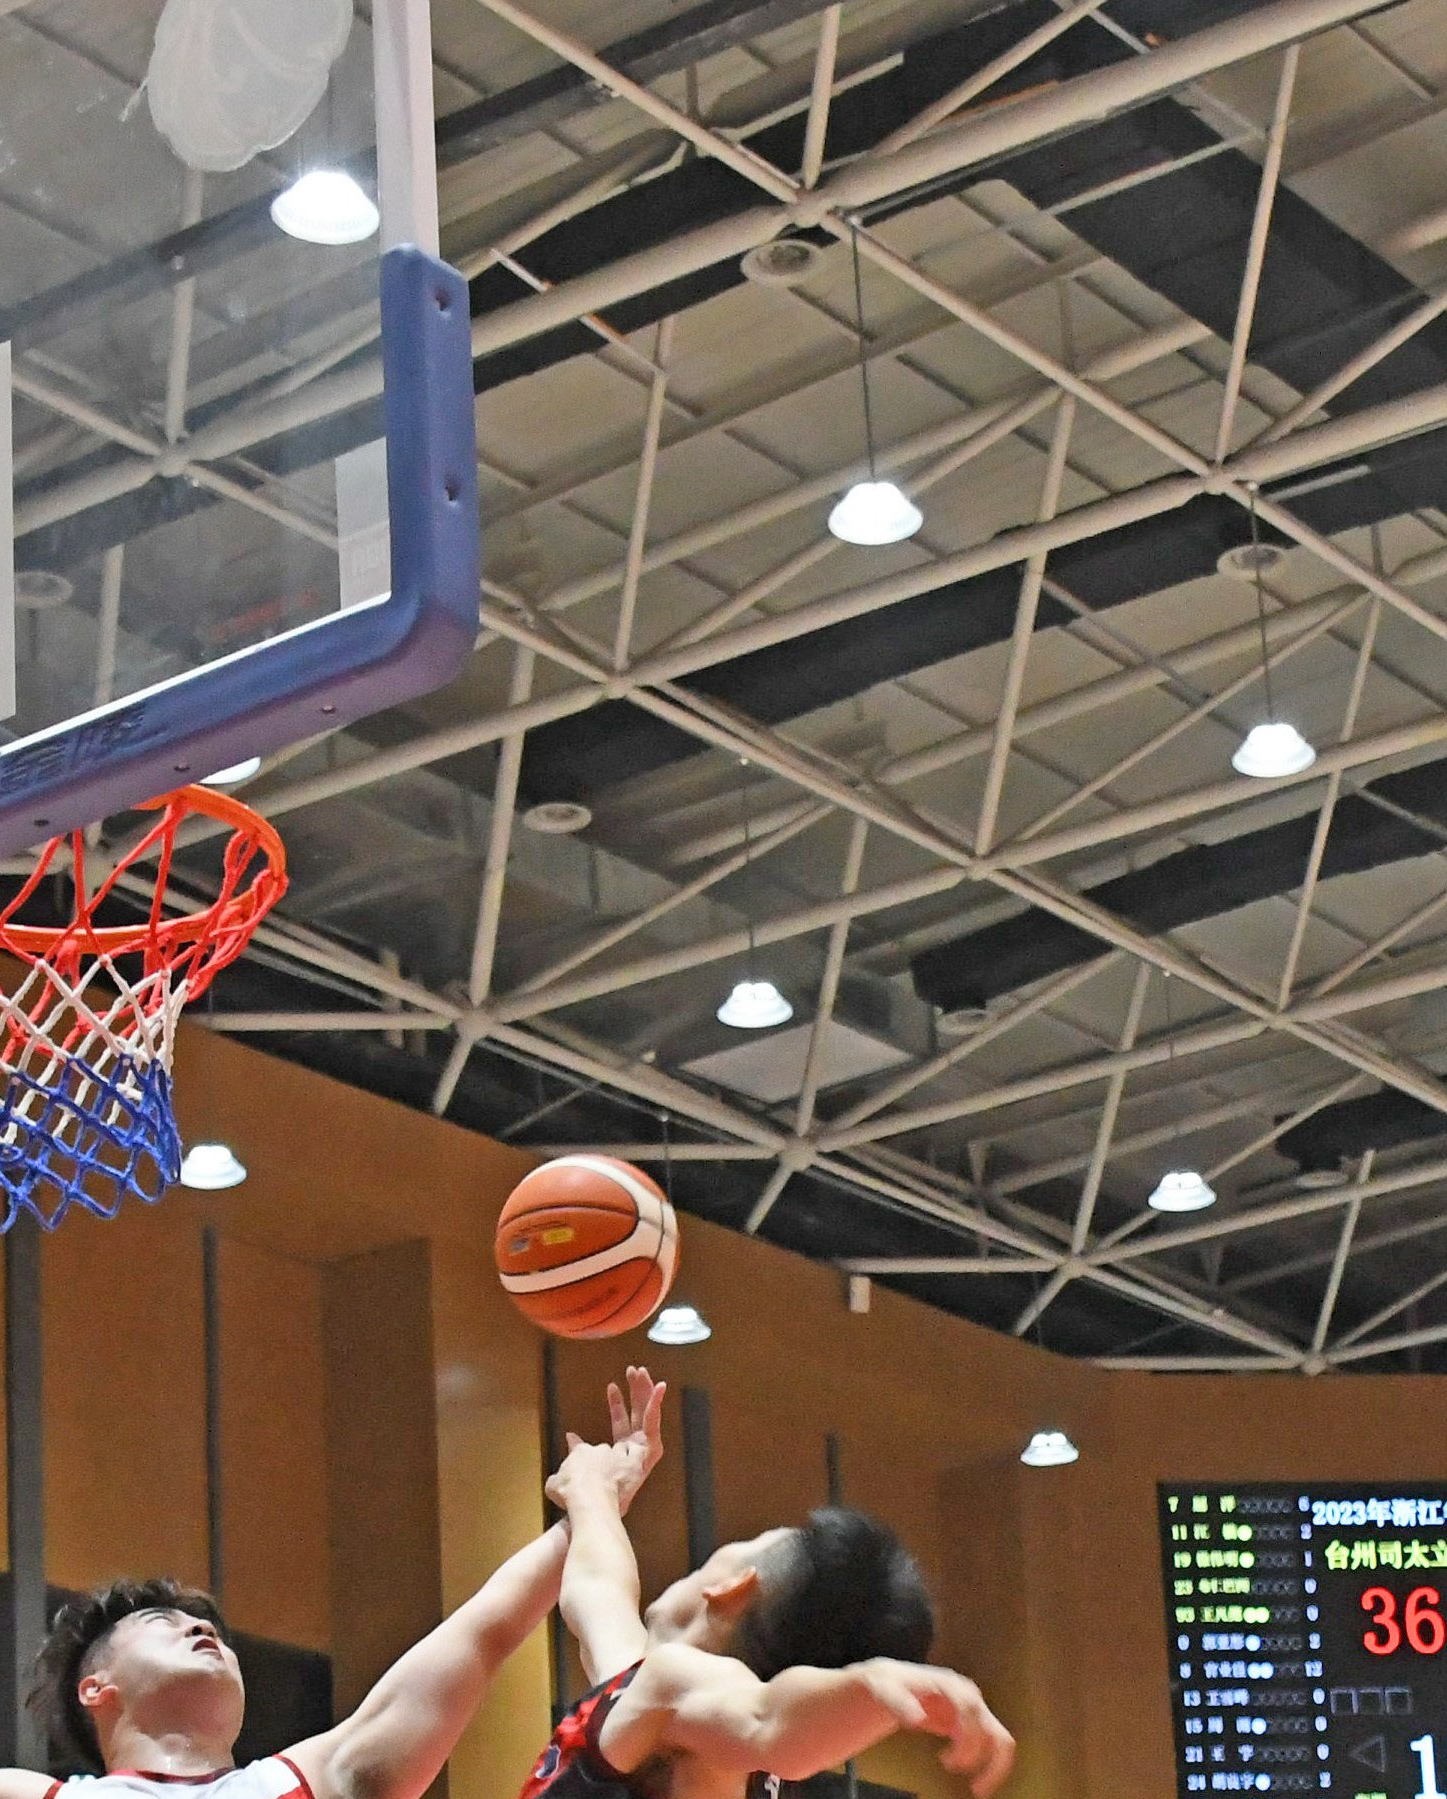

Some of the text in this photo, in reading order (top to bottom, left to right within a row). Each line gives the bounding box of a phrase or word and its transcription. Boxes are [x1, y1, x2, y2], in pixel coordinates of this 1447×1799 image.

[1312, 1498, 1447, 1528] 2023年浙江
[1361, 1586, 1447, 1655] 36
